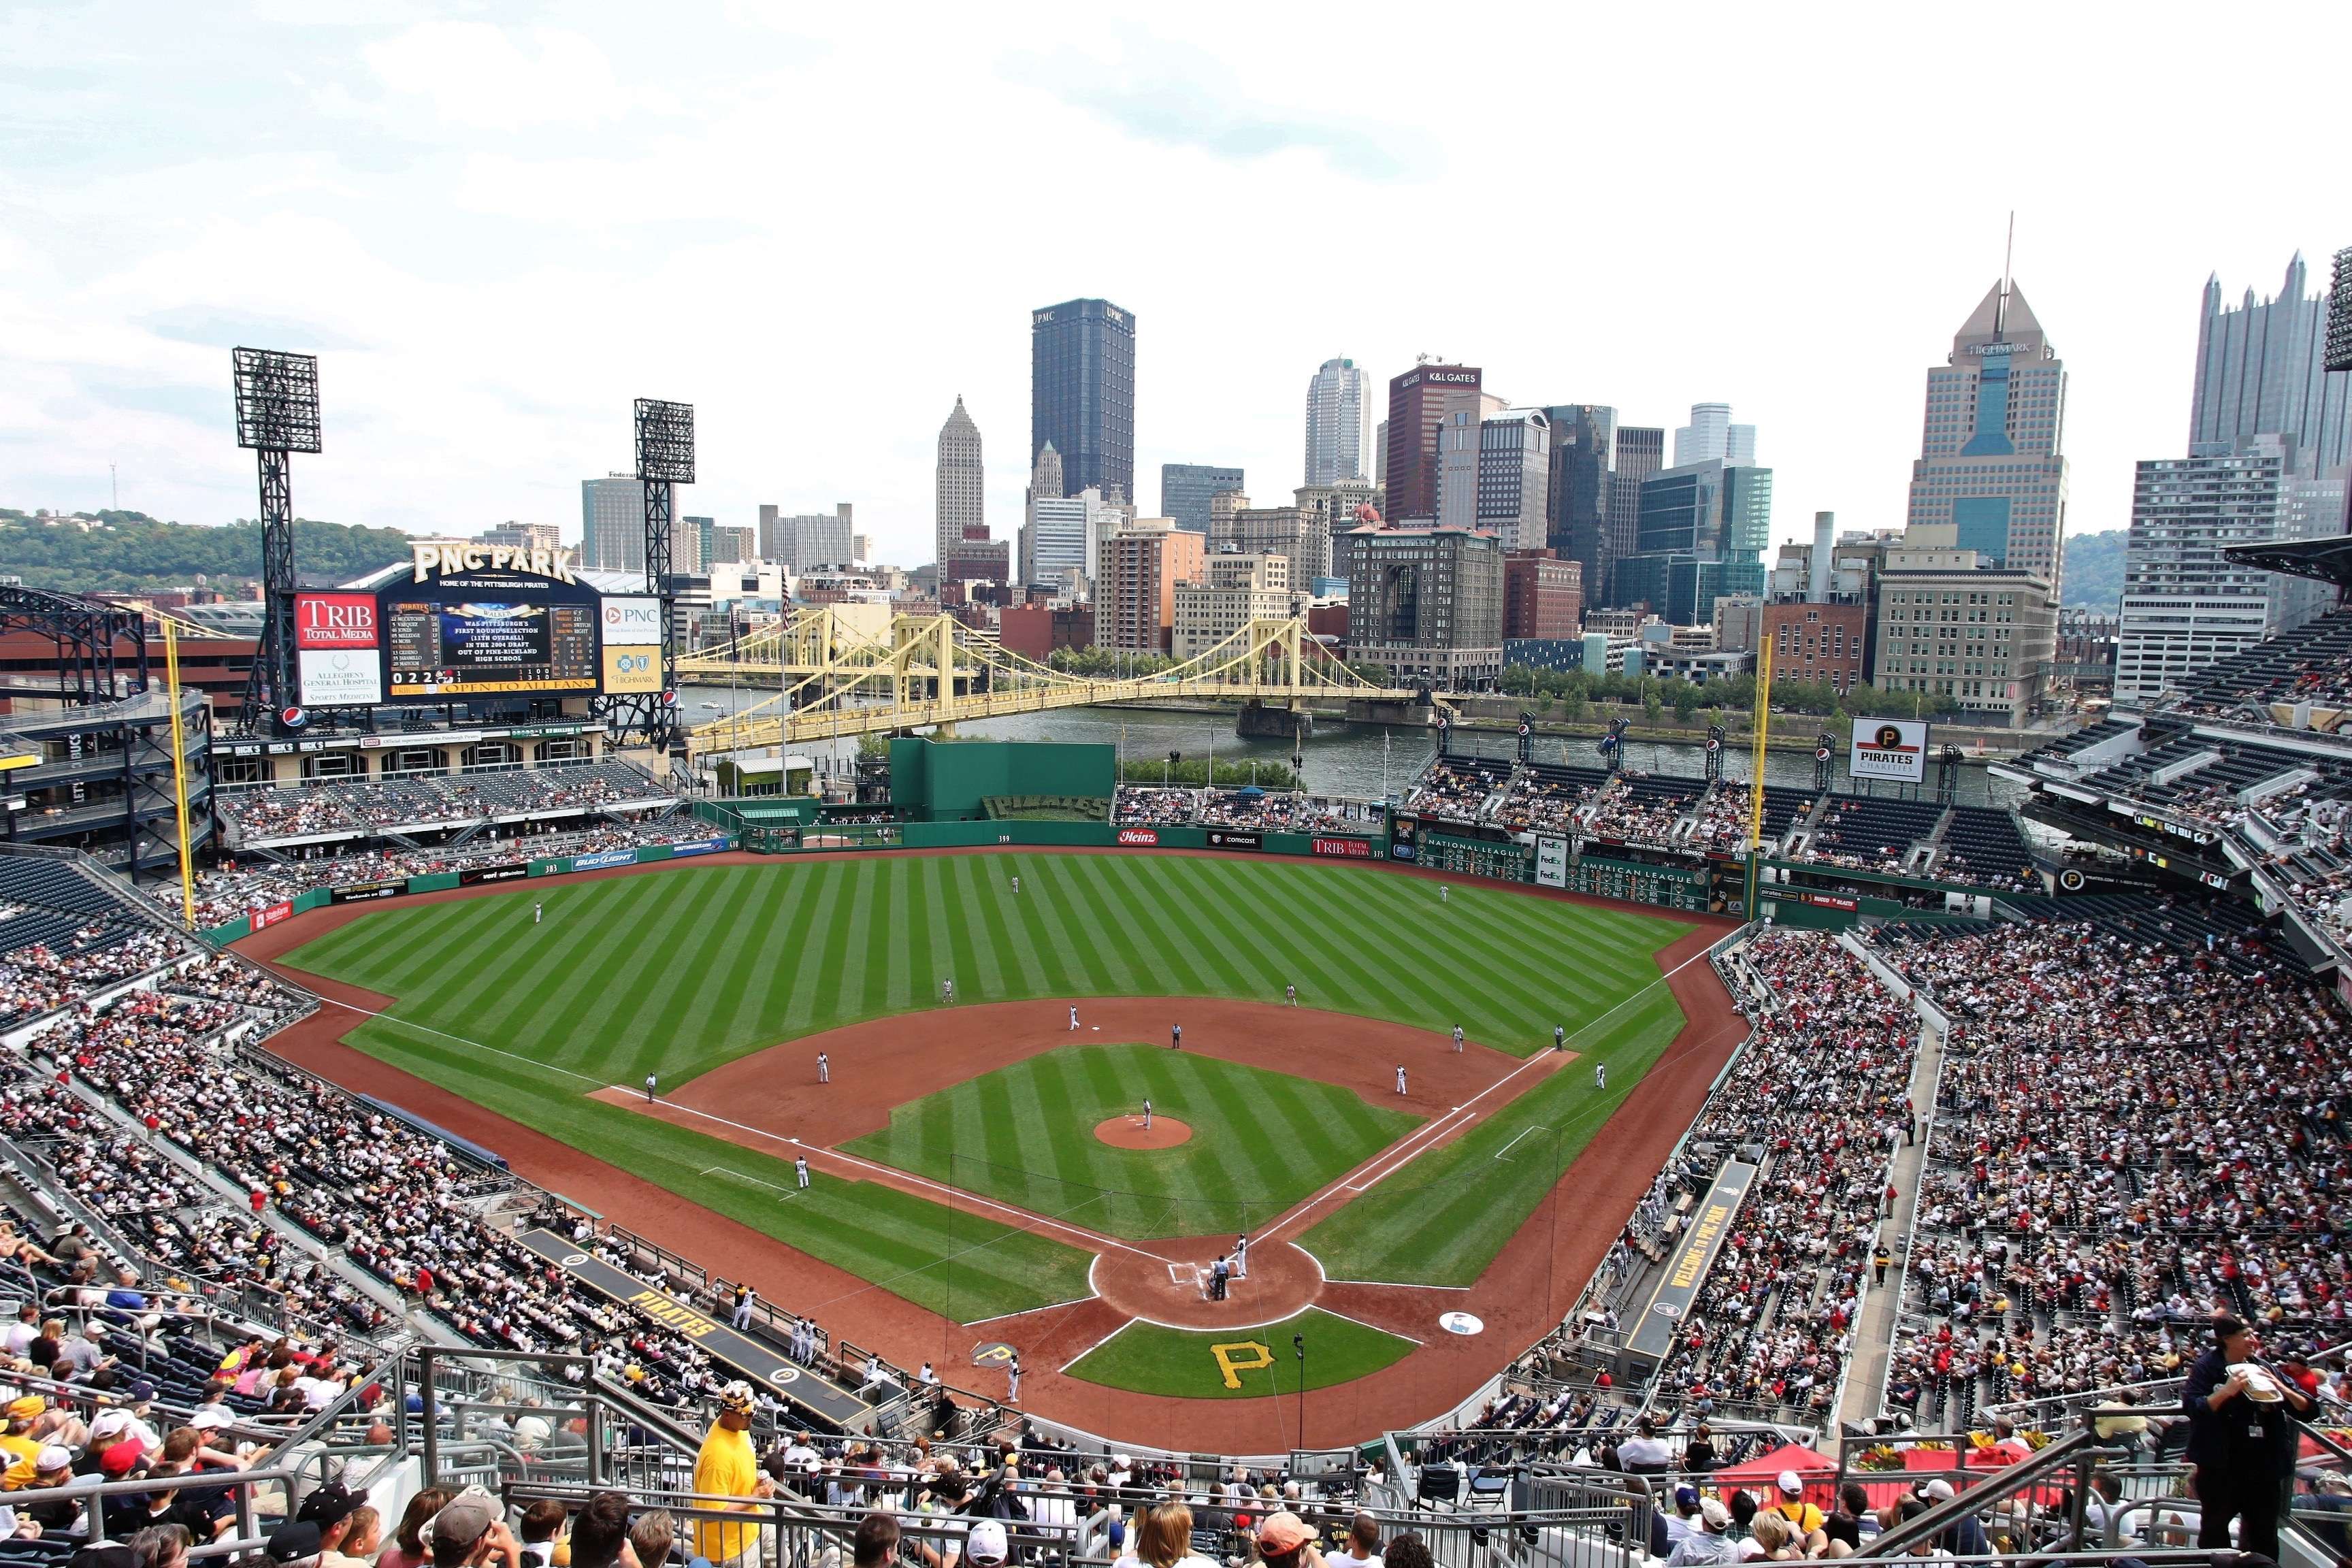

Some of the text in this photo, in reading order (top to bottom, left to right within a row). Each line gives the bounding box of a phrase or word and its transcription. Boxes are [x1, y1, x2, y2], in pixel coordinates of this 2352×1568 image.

[1033, 311, 1056, 325] UPMC
[1107, 307, 1123, 323] UPMC
[1970, 343, 2030, 355] HIGHMARK
[1409, 374, 1420, 385] GATES
[1428, 372, 1475, 382] K&L GATES
[413, 544, 576, 586] PNC PARK
[301, 600, 372, 627] TRIB
[399, 604, 429, 614] PIRATES
[625, 609, 657, 622] PNC
[304, 628, 374, 639] TOTAL MEDIA
[393, 672, 431, 683] 0 2 2
[446, 683, 490, 693] OPEN
[499, 683, 519, 691] TO
[1883, 731, 1895, 746] P
[69, 734, 82, 760] BUCS
[1861, 751, 1913, 765] PIRATES
[1860, 762, 1913, 772] CHARITIES
[2164, 822, 2177, 834] GO
[999, 834, 1010, 843] 399
[1119, 832, 1156, 843] Heinz
[1578, 834, 1601, 843] CONSOL
[674, 843, 712, 851] SOUTHWEST.COM
[1312, 838, 1345, 854] TRIB
[1348, 841, 1369, 849] TOTAL
[1396, 846, 1411, 855] FSN
[1428, 839, 1478, 851] NATIONAL
[1482, 847, 1520, 858] LEAGUE
[1541, 840, 1562, 850] FedEx
[1652, 844, 1669, 852] Switch
[1349, 848, 1369, 856] MEDIA
[1681, 849, 1706, 858] CONSOL
[1734, 852, 1746, 860] 320
[575, 852, 634, 867] BUD LIGHT
[1541, 855, 1561, 865] FedEx
[545, 864, 557, 873] 383
[1582, 862, 1641, 875] AMERICAN
[1646, 871, 1692, 884] LEAGUE
[483, 871, 508, 879] verion
[1540, 870, 1560, 881] FedEx
[2068, 874, 2078, 885] P
[1761, 889, 1797, 900] pirates.com
[1671, 1205, 1729, 1288] WELCOME TO PNC PARK
[629, 1291, 716, 1337] PIRATES
[1210, 1340, 1276, 1389] P
